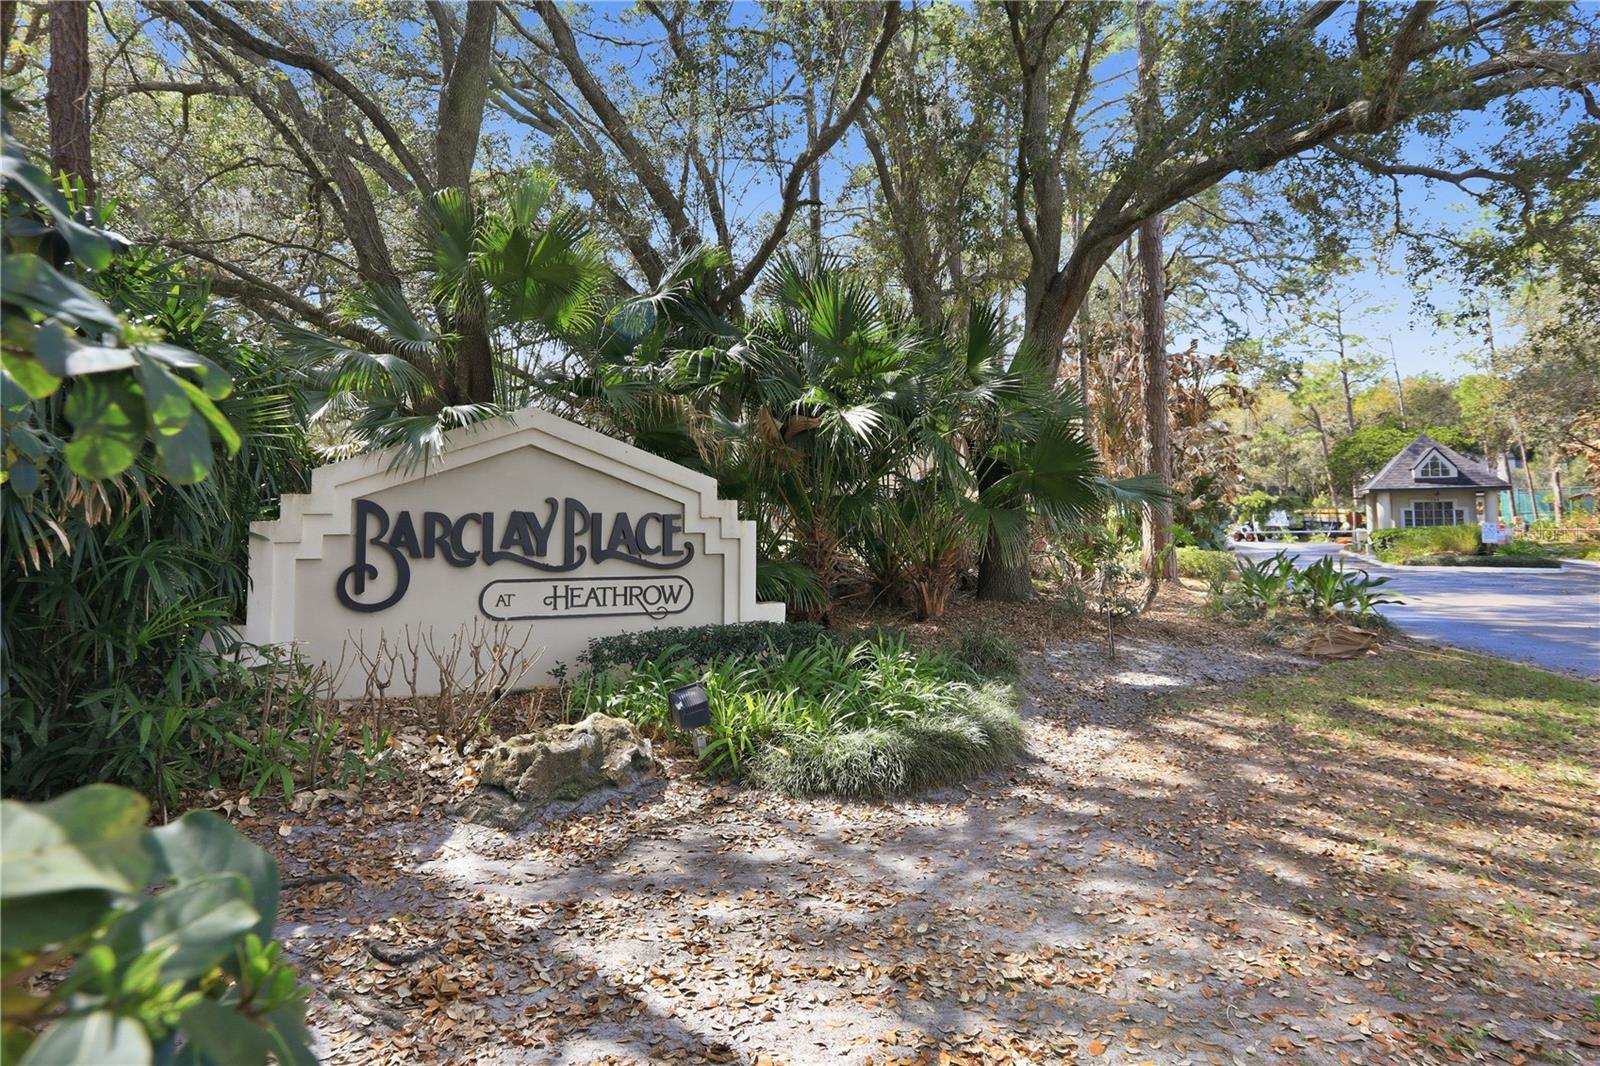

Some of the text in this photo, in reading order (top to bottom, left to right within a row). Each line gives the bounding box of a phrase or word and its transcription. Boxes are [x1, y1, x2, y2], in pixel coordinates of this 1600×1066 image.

[336, 497, 695, 613] BARCLAY PLACE
[495, 584, 684, 620] AT HEATHROW
